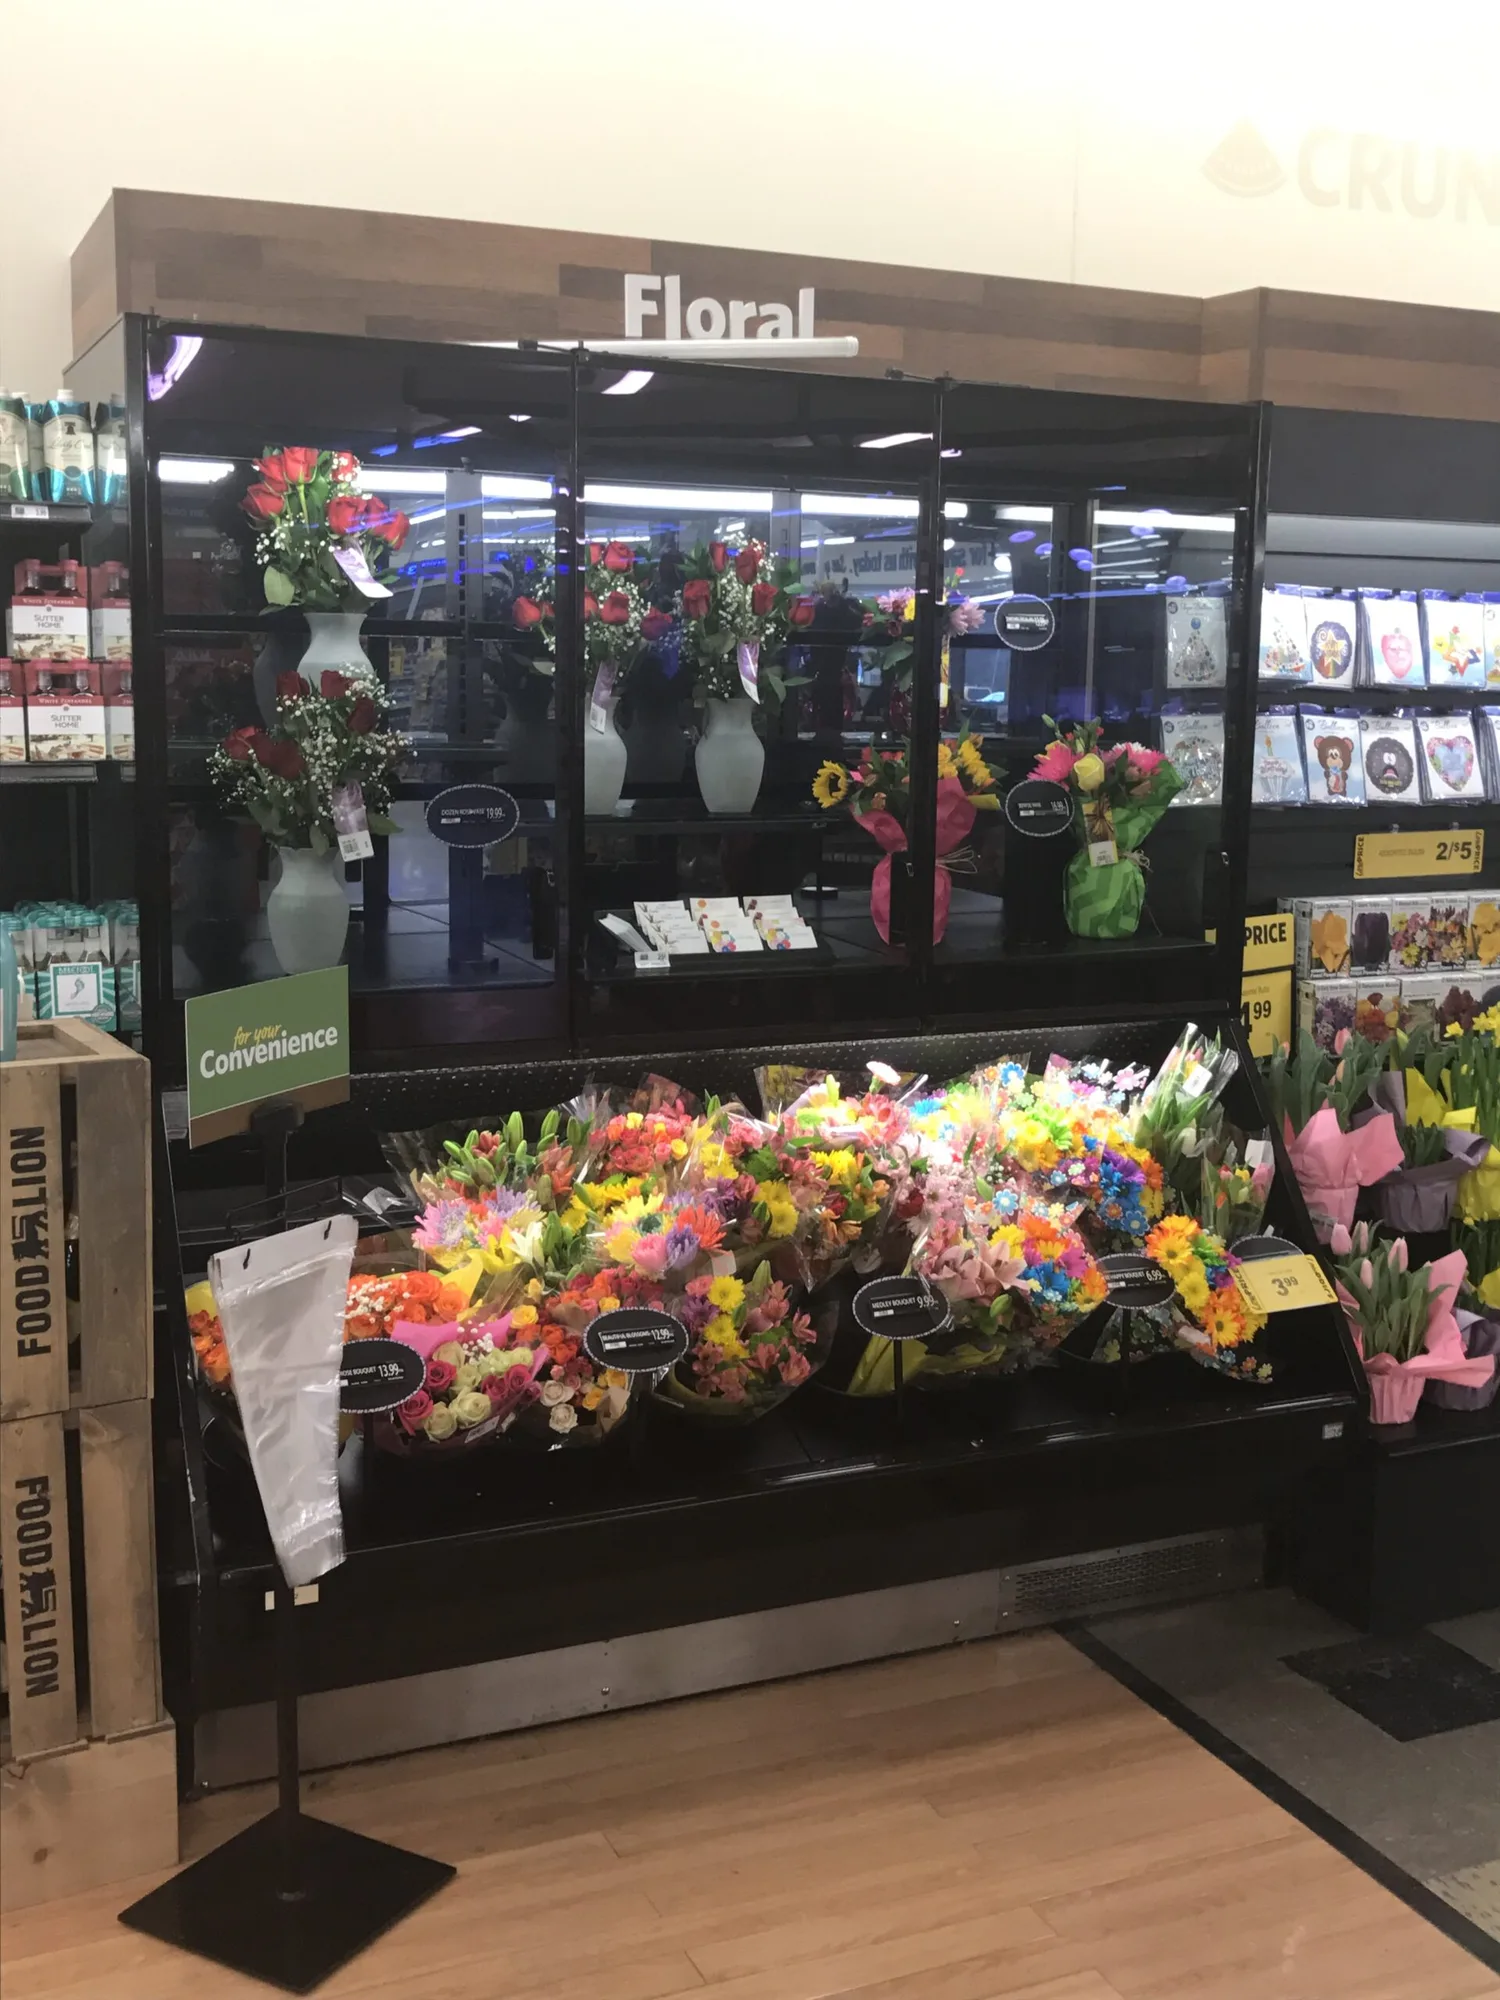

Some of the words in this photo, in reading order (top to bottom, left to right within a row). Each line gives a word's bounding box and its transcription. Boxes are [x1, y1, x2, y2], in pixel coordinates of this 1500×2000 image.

[624, 273, 815, 340] Floral
[34, 614, 64, 622] SUTTER
[51, 714, 82, 722] SUTTER
[441, 808, 460, 816] DOZEN
[486, 807, 503, 819] 19.99
[1244, 921, 1287, 946] PRICE
[234, 1027, 251, 1050] for
[253, 1022, 282, 1044] your
[199, 1026, 339, 1080] Convenience
[10, 1126, 48, 1208] LION
[1146, 1270, 1162, 1281] 6.99
[15, 1264, 52, 1358] FOOD
[872, 1300, 892, 1309] MEDLEY
[892, 1297, 916, 1307] BOUQUET
[916, 1295, 934, 1308] 9.99
[602, 1332, 626, 1342] BEAUTIFUL
[651, 1328, 670, 1340] 12.99
[352, 1366, 376, 1376] BOUQUET
[378, 1362, 399, 1378] 13.99
[15, 1475, 52, 1568] FOOD
[22, 1619, 59, 1698] LION
